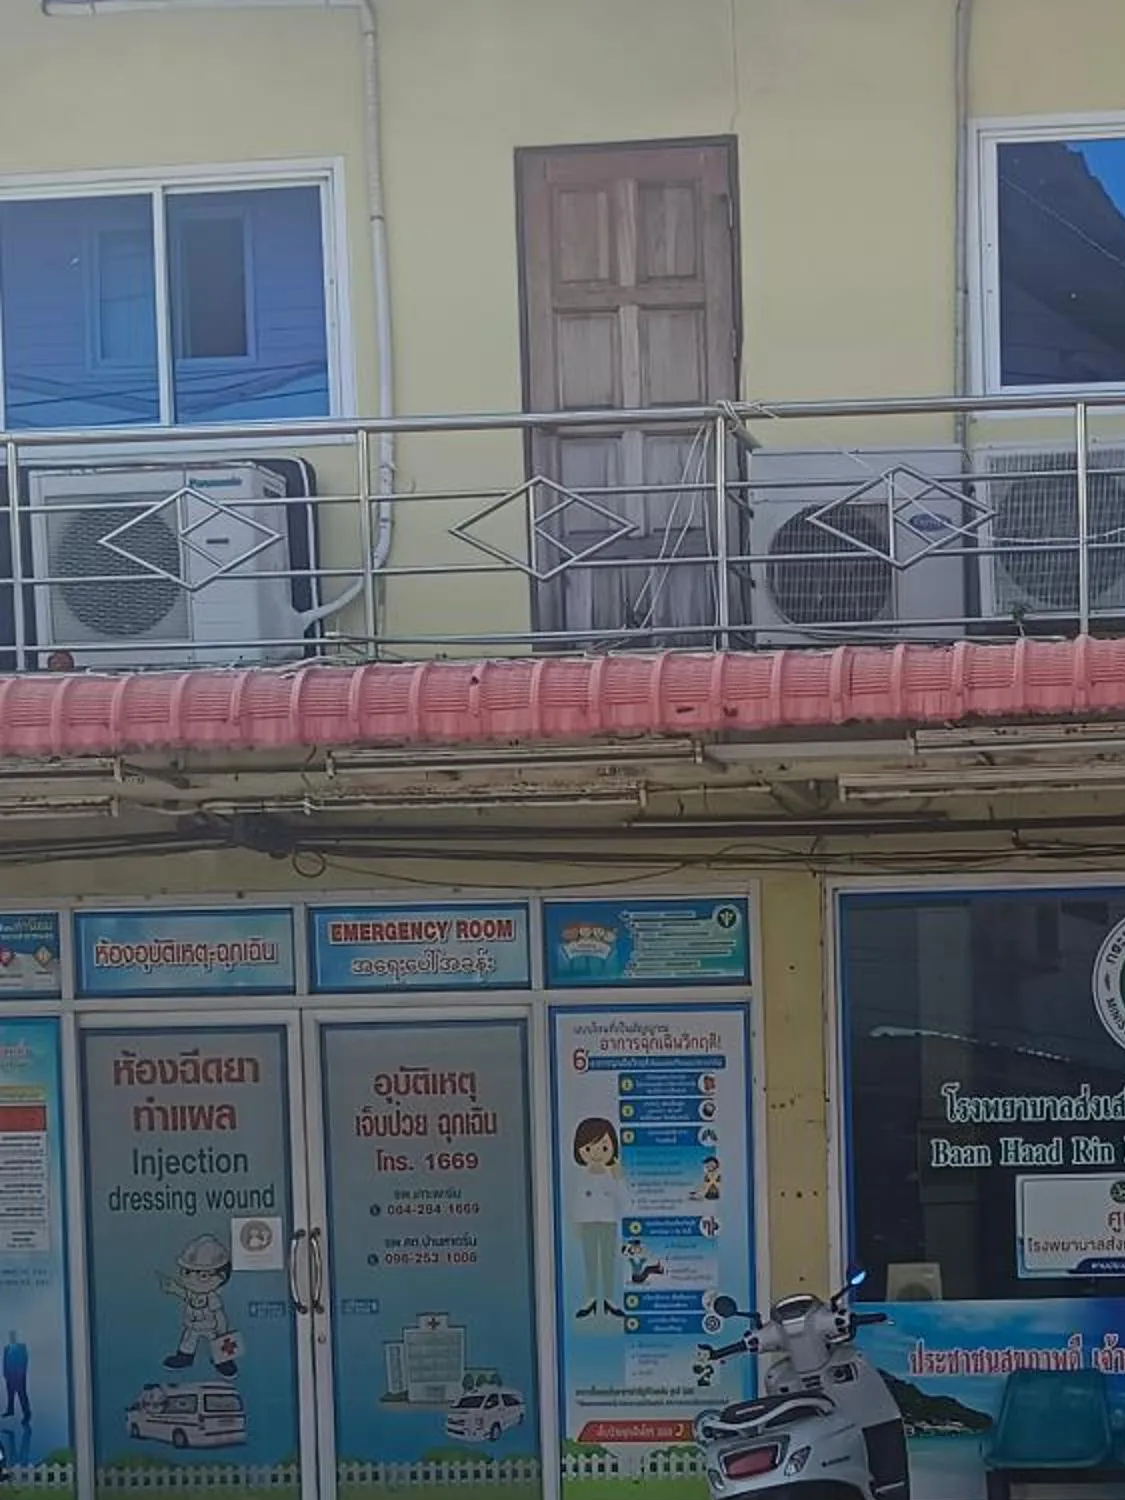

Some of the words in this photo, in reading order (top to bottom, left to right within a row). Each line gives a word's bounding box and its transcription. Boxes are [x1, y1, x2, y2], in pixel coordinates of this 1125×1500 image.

[330, 920, 452, 942] EMERGENCY
[455, 919, 514, 940] ROOM
[113, 1049, 260, 1086] ห้องฉีดยา
[374, 1066, 477, 1103] อุบัติเหตุ
[132, 1097, 237, 1132] ทำแผล
[355, 1101, 428, 1137] เจ็บป่วย
[438, 1107, 498, 1143] ฉุกเฉิน
[132, 1148, 249, 1181] Injection
[375, 1149, 415, 1171] โทร.
[425, 1152, 479, 1170] 1669
[930, 1138, 992, 1167] Baan
[999, 1136, 1064, 1165] Haad
[1071, 1136, 1115, 1165] Rin
[109, 1186, 197, 1216] dressing
[206, 1185, 275, 1209] wound
